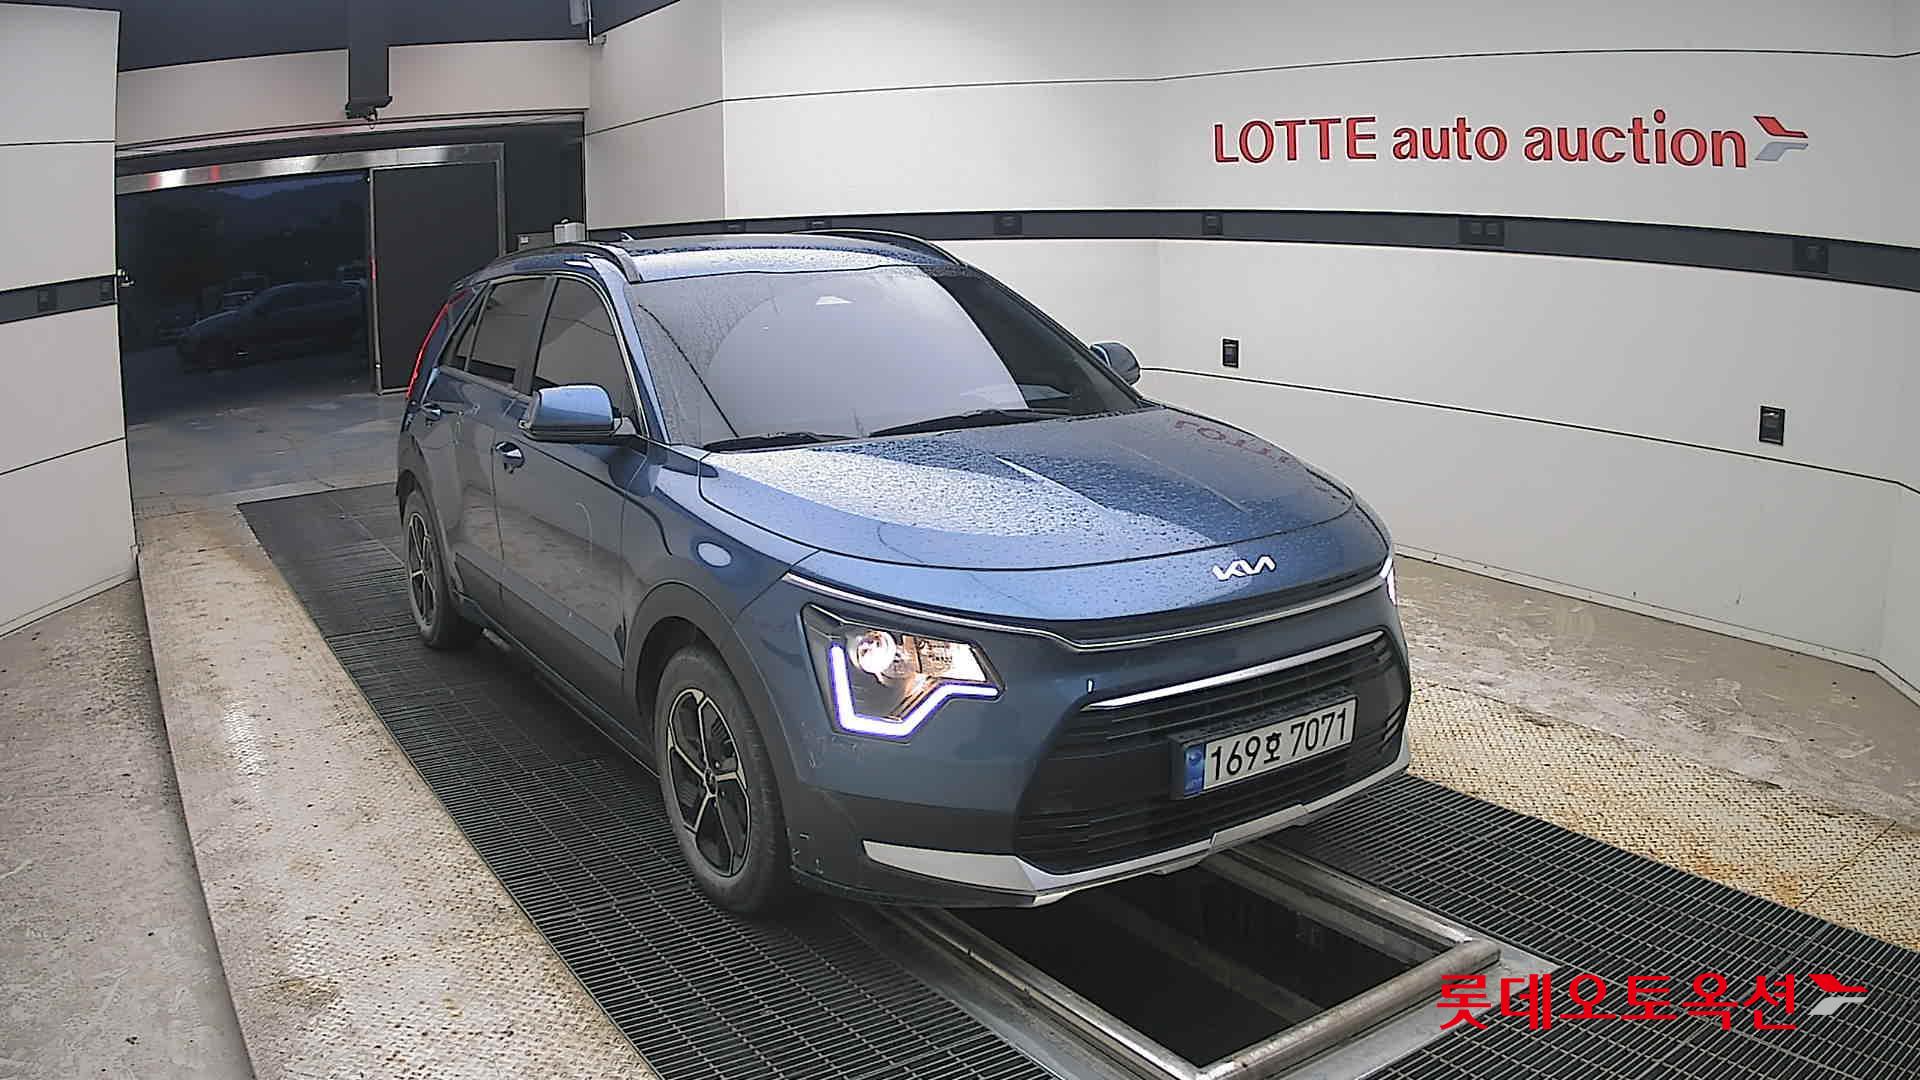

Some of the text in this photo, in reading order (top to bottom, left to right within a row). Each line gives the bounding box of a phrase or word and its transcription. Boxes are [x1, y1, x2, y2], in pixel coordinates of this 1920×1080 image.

[1214, 109, 1746, 168] LOTTE auto auction
[1211, 708, 1347, 780] 169호 7071
